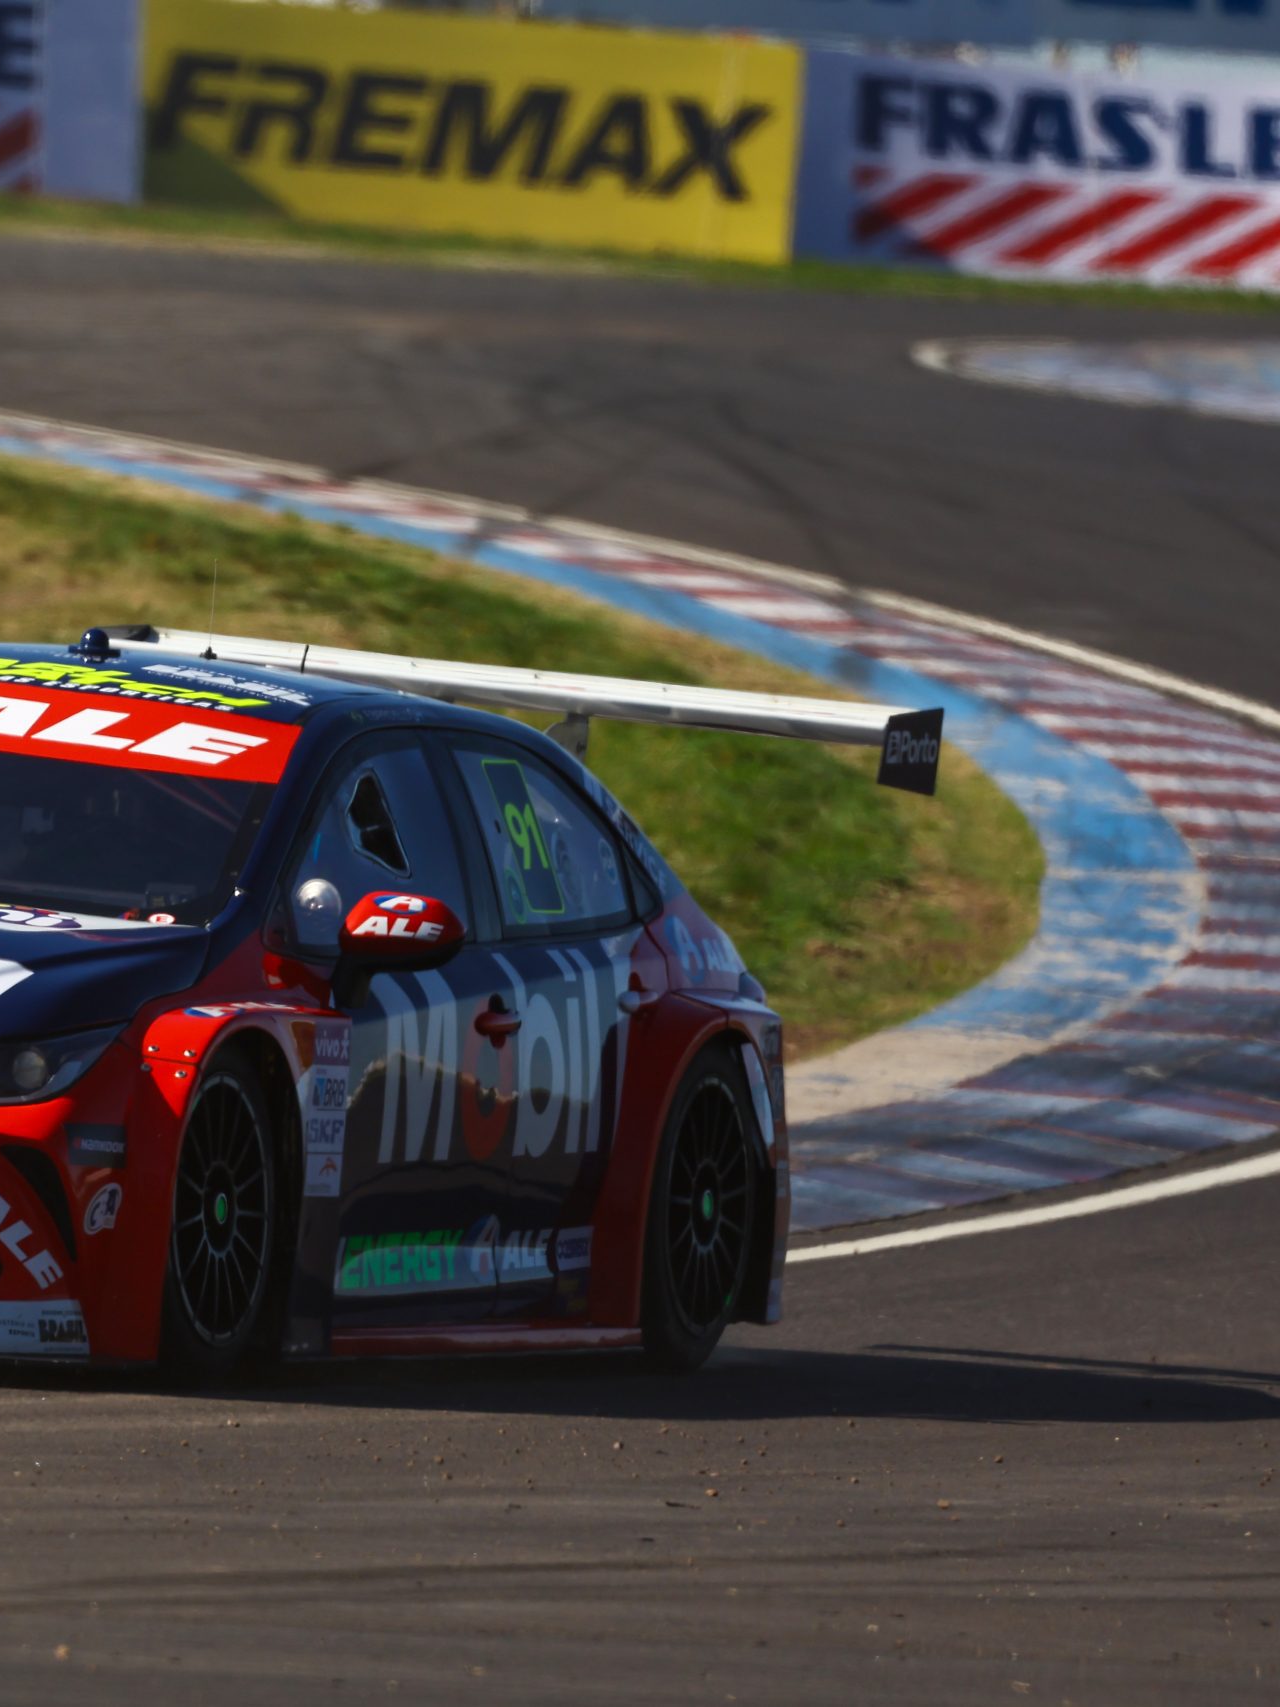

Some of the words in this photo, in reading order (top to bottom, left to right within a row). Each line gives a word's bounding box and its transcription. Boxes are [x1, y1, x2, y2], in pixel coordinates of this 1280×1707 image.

[153, 49, 771, 203] FREMAX
[504, 803, 549, 870] 91
[352, 916, 444, 941] ALE
[315, 1030, 340, 1058] vivo
[367, 948, 602, 1164] Mobil
[340, 1229, 464, 1290] ENERGY
[502, 1228, 549, 1271] ALE
